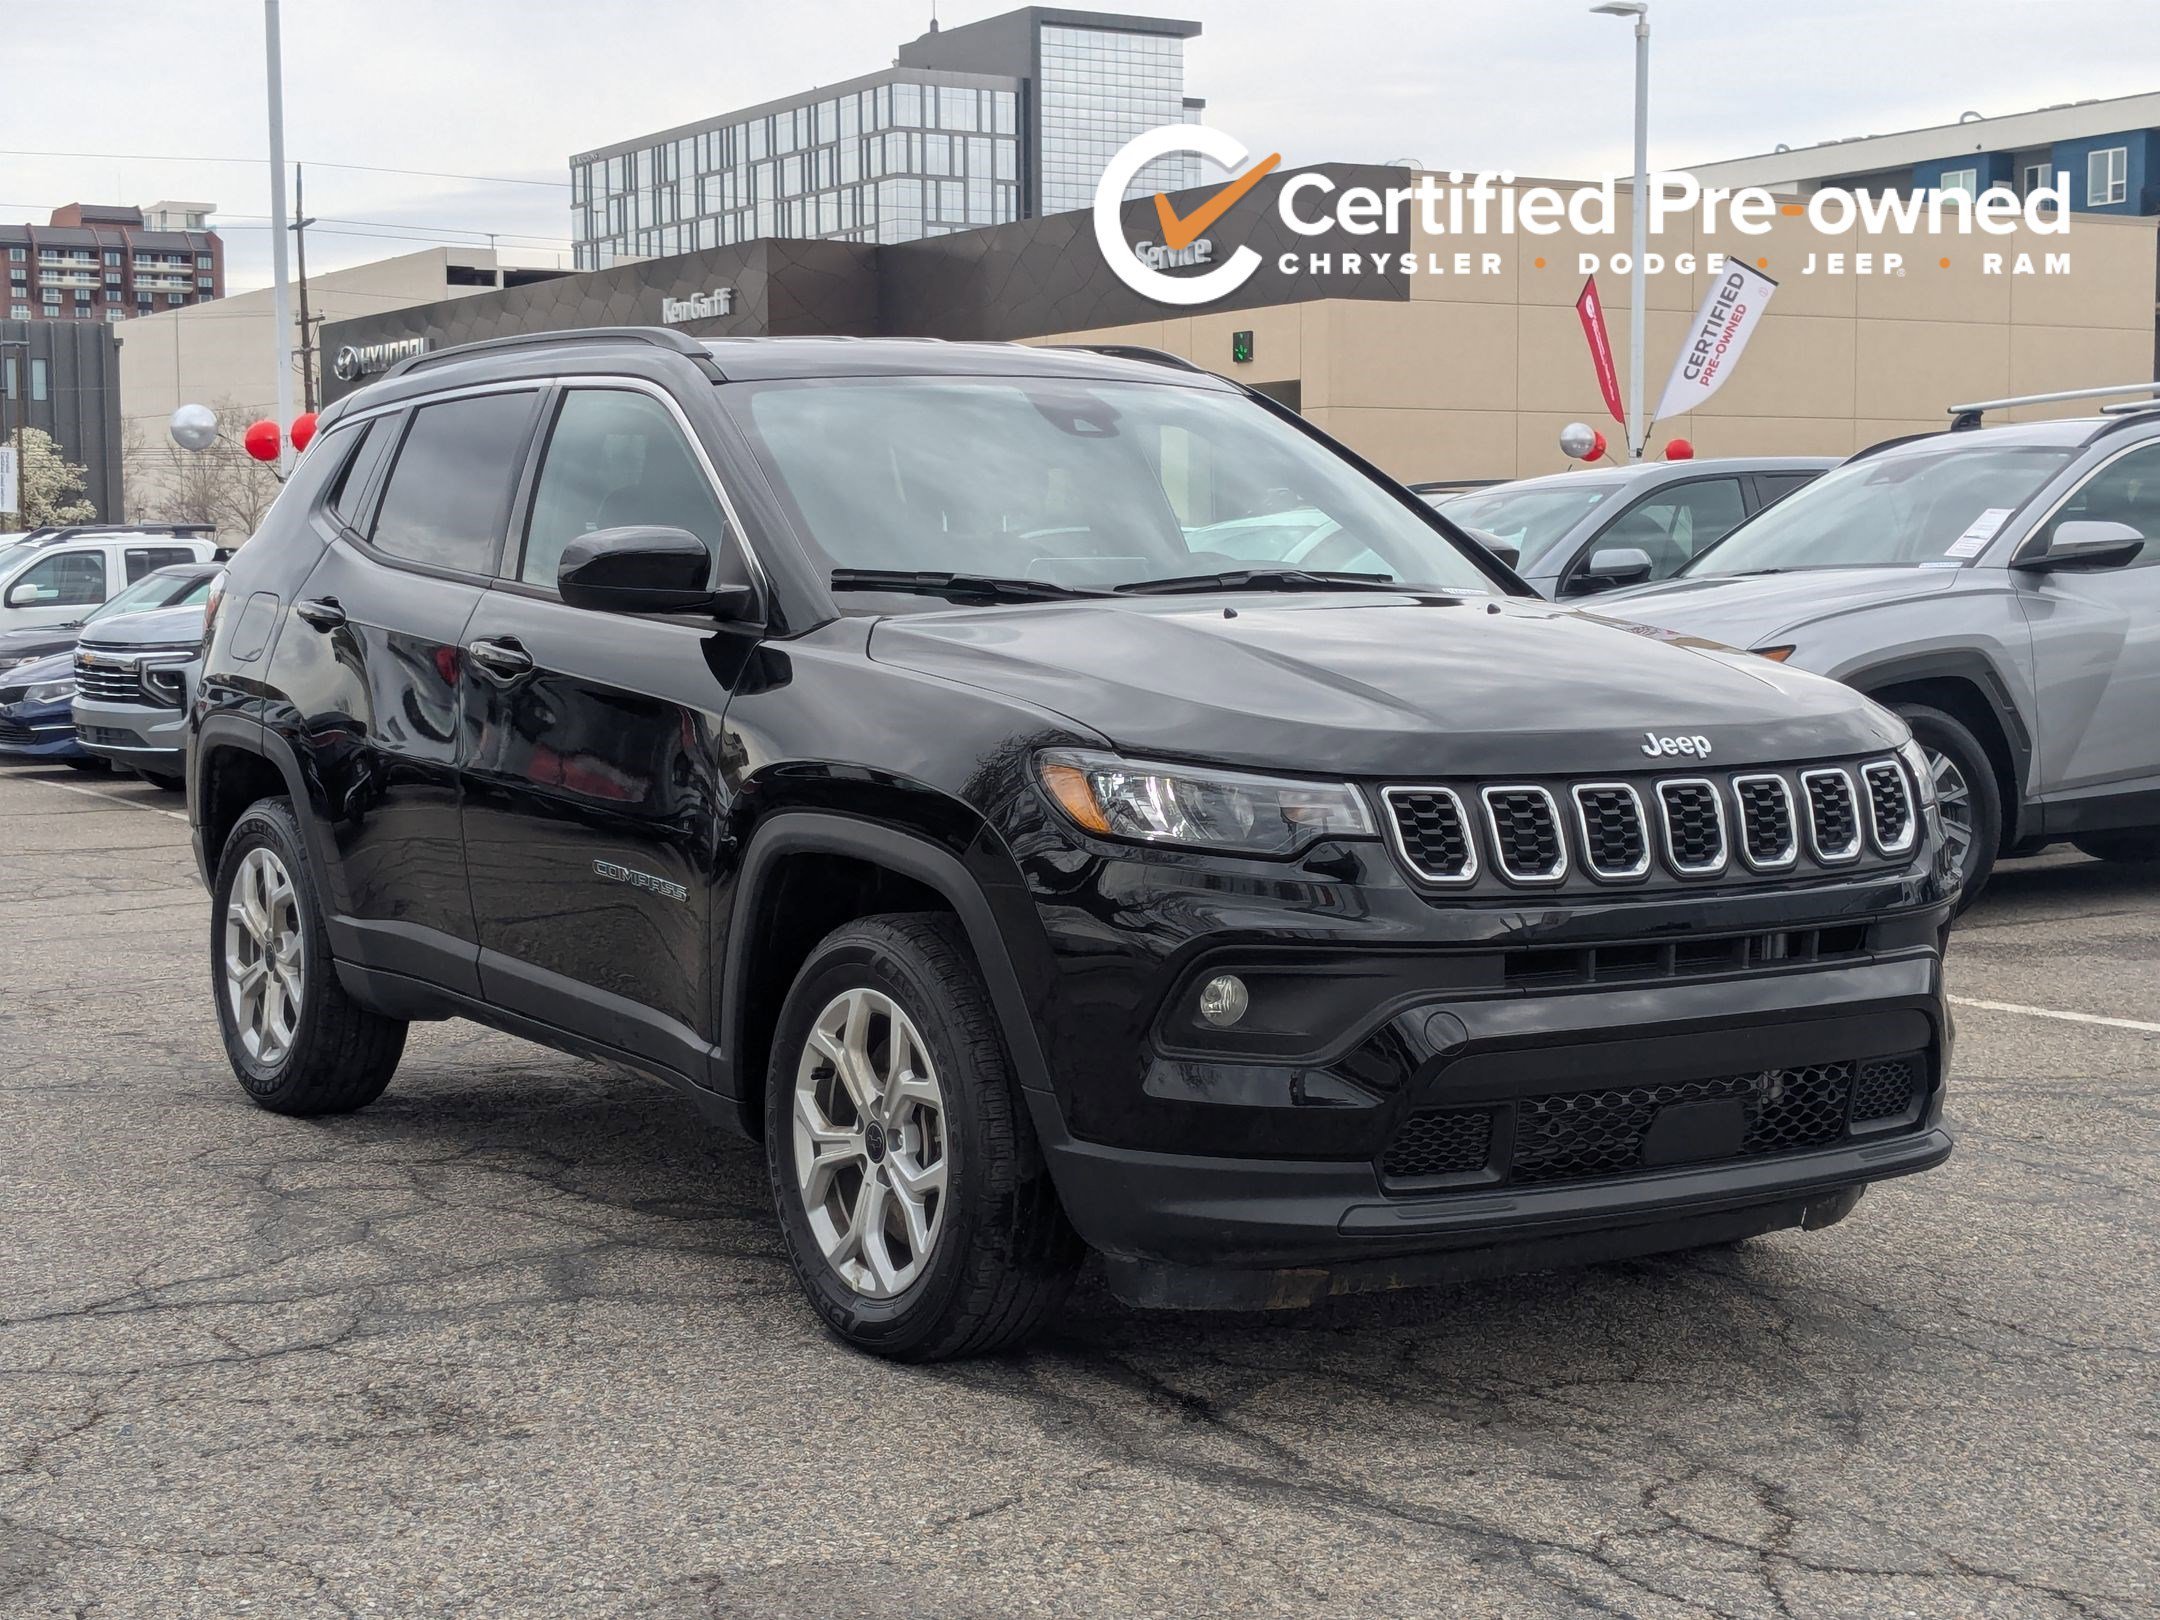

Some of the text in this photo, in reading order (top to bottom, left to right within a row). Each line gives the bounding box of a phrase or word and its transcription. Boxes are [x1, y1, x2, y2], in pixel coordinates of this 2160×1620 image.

[1684, 272, 1746, 380] CERTIFIED
[1700, 303, 1747, 386] PRE-OWNED
[1641, 732, 1712, 759] Jeep
[592, 859, 689, 902] COMPASS
